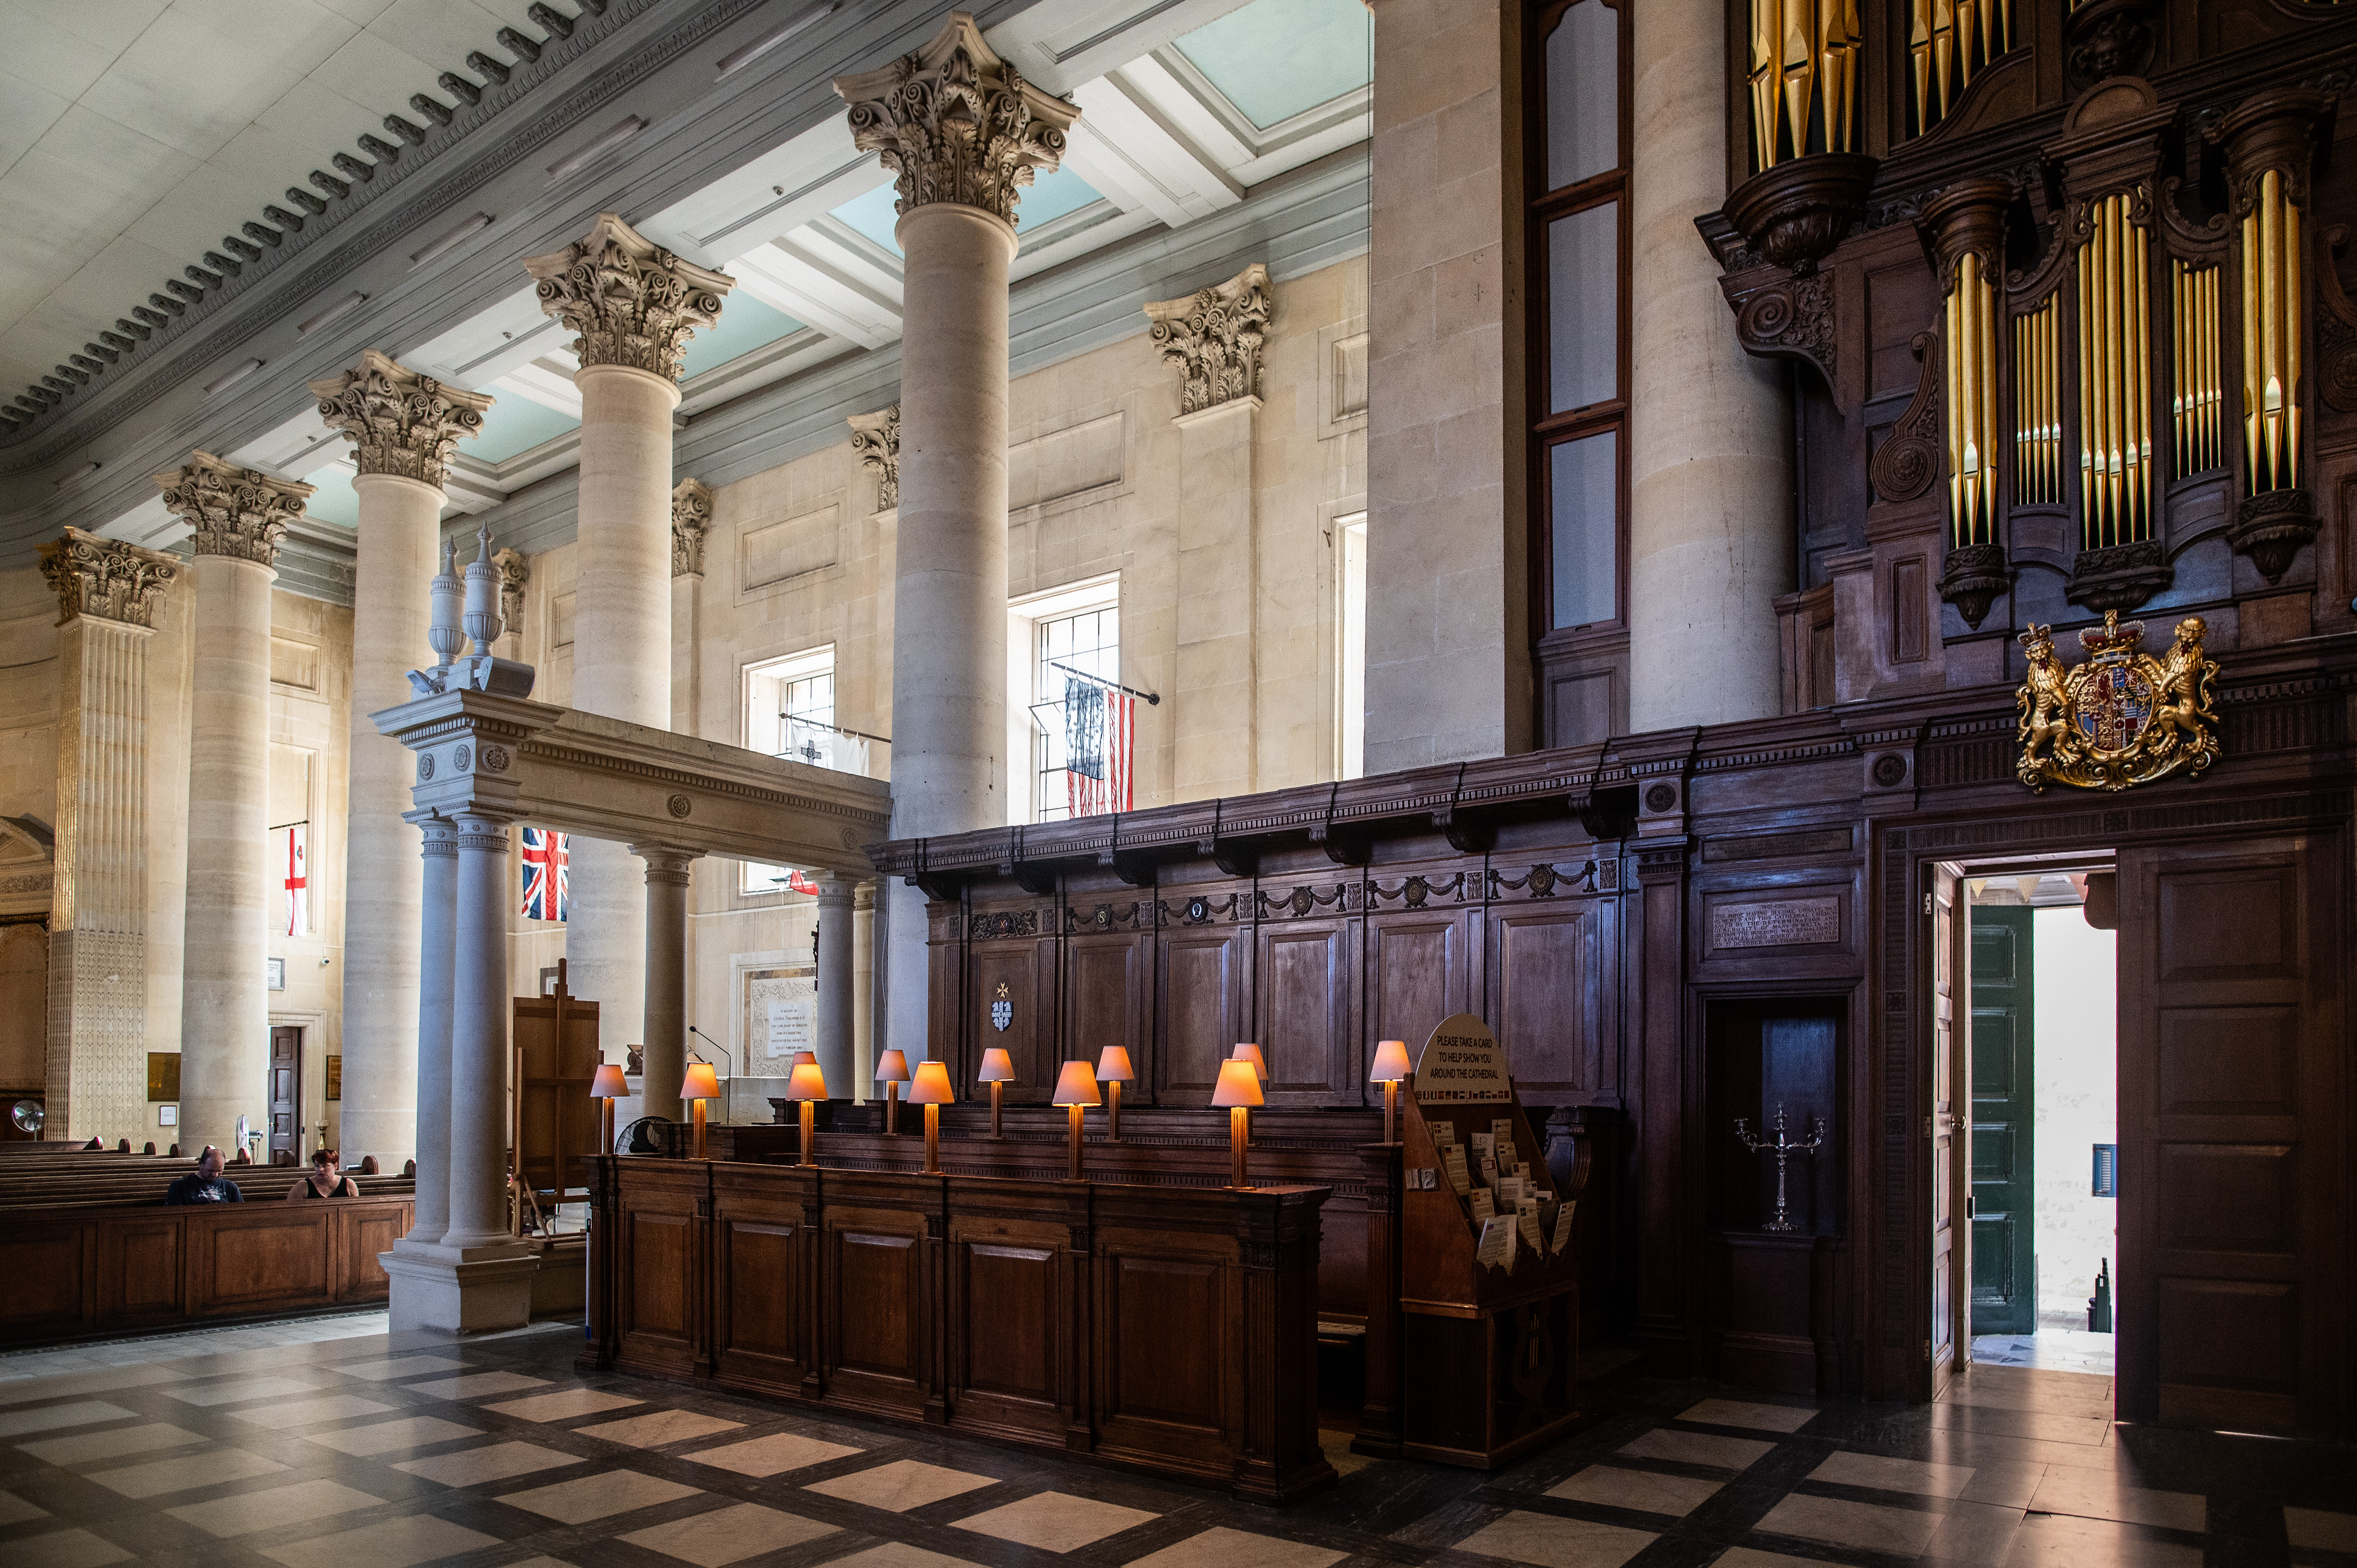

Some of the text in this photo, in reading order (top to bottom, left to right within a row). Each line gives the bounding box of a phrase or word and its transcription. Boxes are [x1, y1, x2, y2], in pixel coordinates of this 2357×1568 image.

[1763, 916, 1820, 925] DETERMINATION
[1437, 1036, 1492, 1048] PLEASE TAKE A CARD
[1438, 1052, 1491, 1064] TO HELP SHOW YOU
[1430, 1068, 1499, 1079] AROUND THE CATHEDRAL
